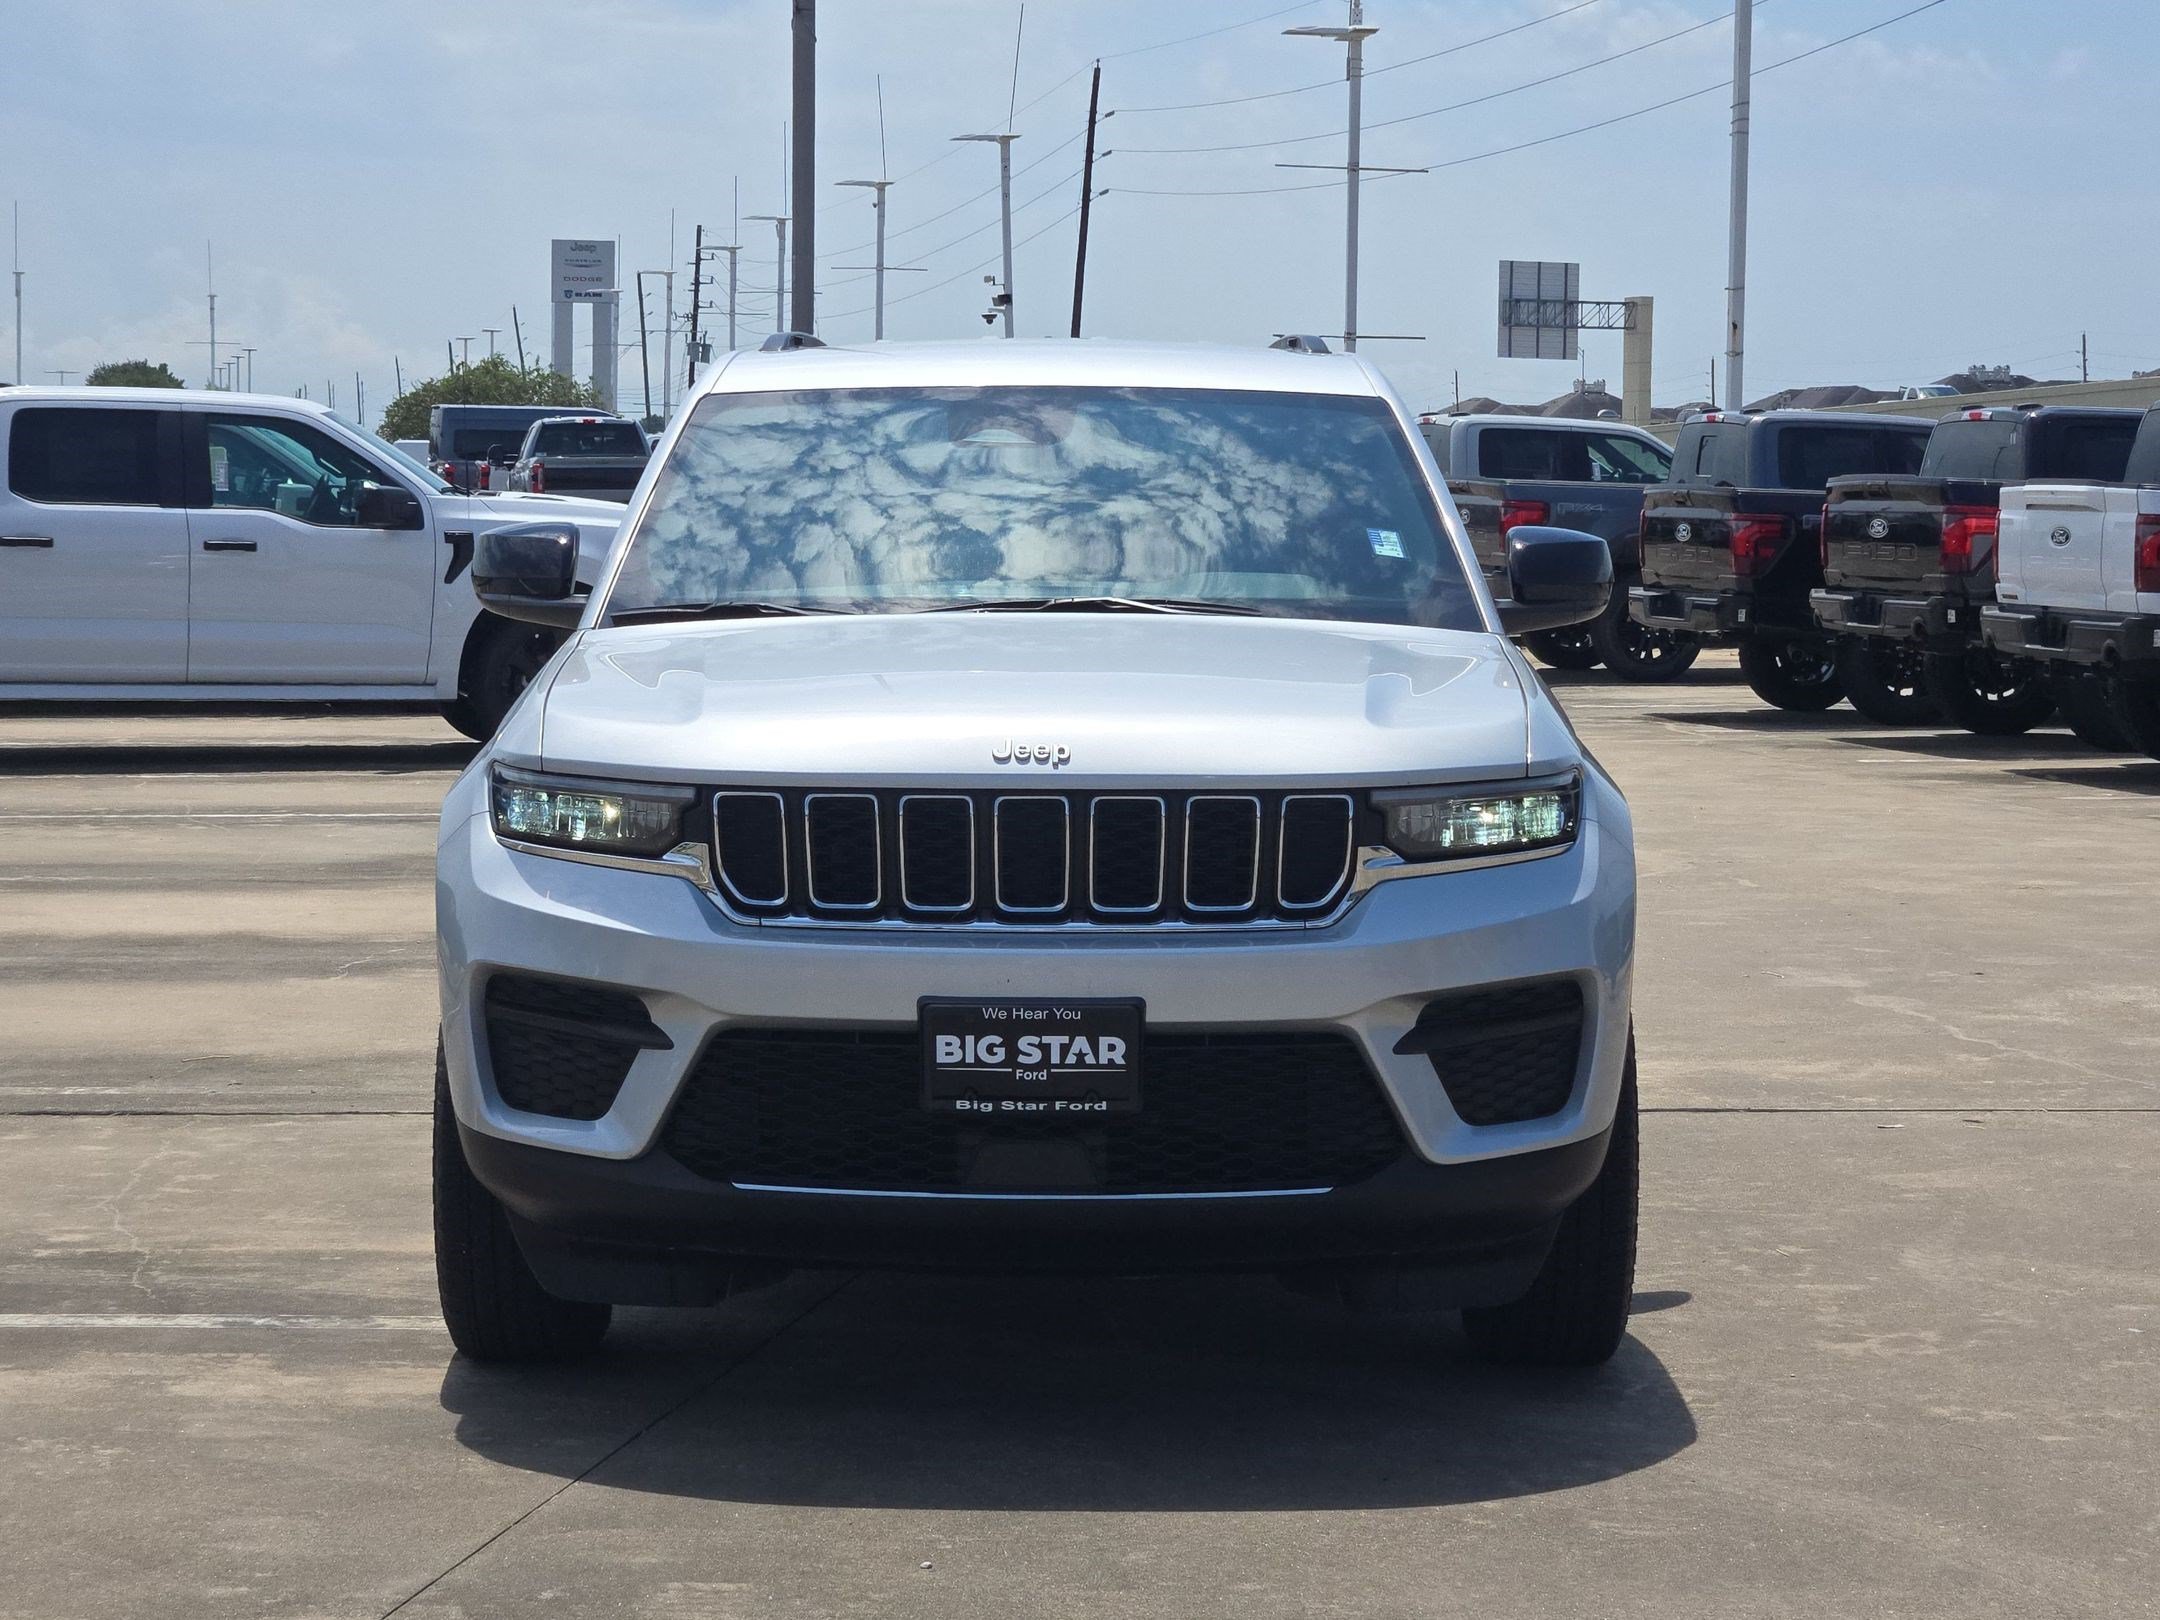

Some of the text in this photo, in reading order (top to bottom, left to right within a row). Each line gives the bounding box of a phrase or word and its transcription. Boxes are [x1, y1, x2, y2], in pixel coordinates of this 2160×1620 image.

[569, 242, 597, 253] Jeep
[992, 737, 1071, 770] Jeep
[982, 1007, 1081, 1020] We Hear You
[935, 1034, 1127, 1065] BIG STAR
[1015, 1069, 1047, 1081] Ford
[955, 1100, 1107, 1112] Big Star Ford
